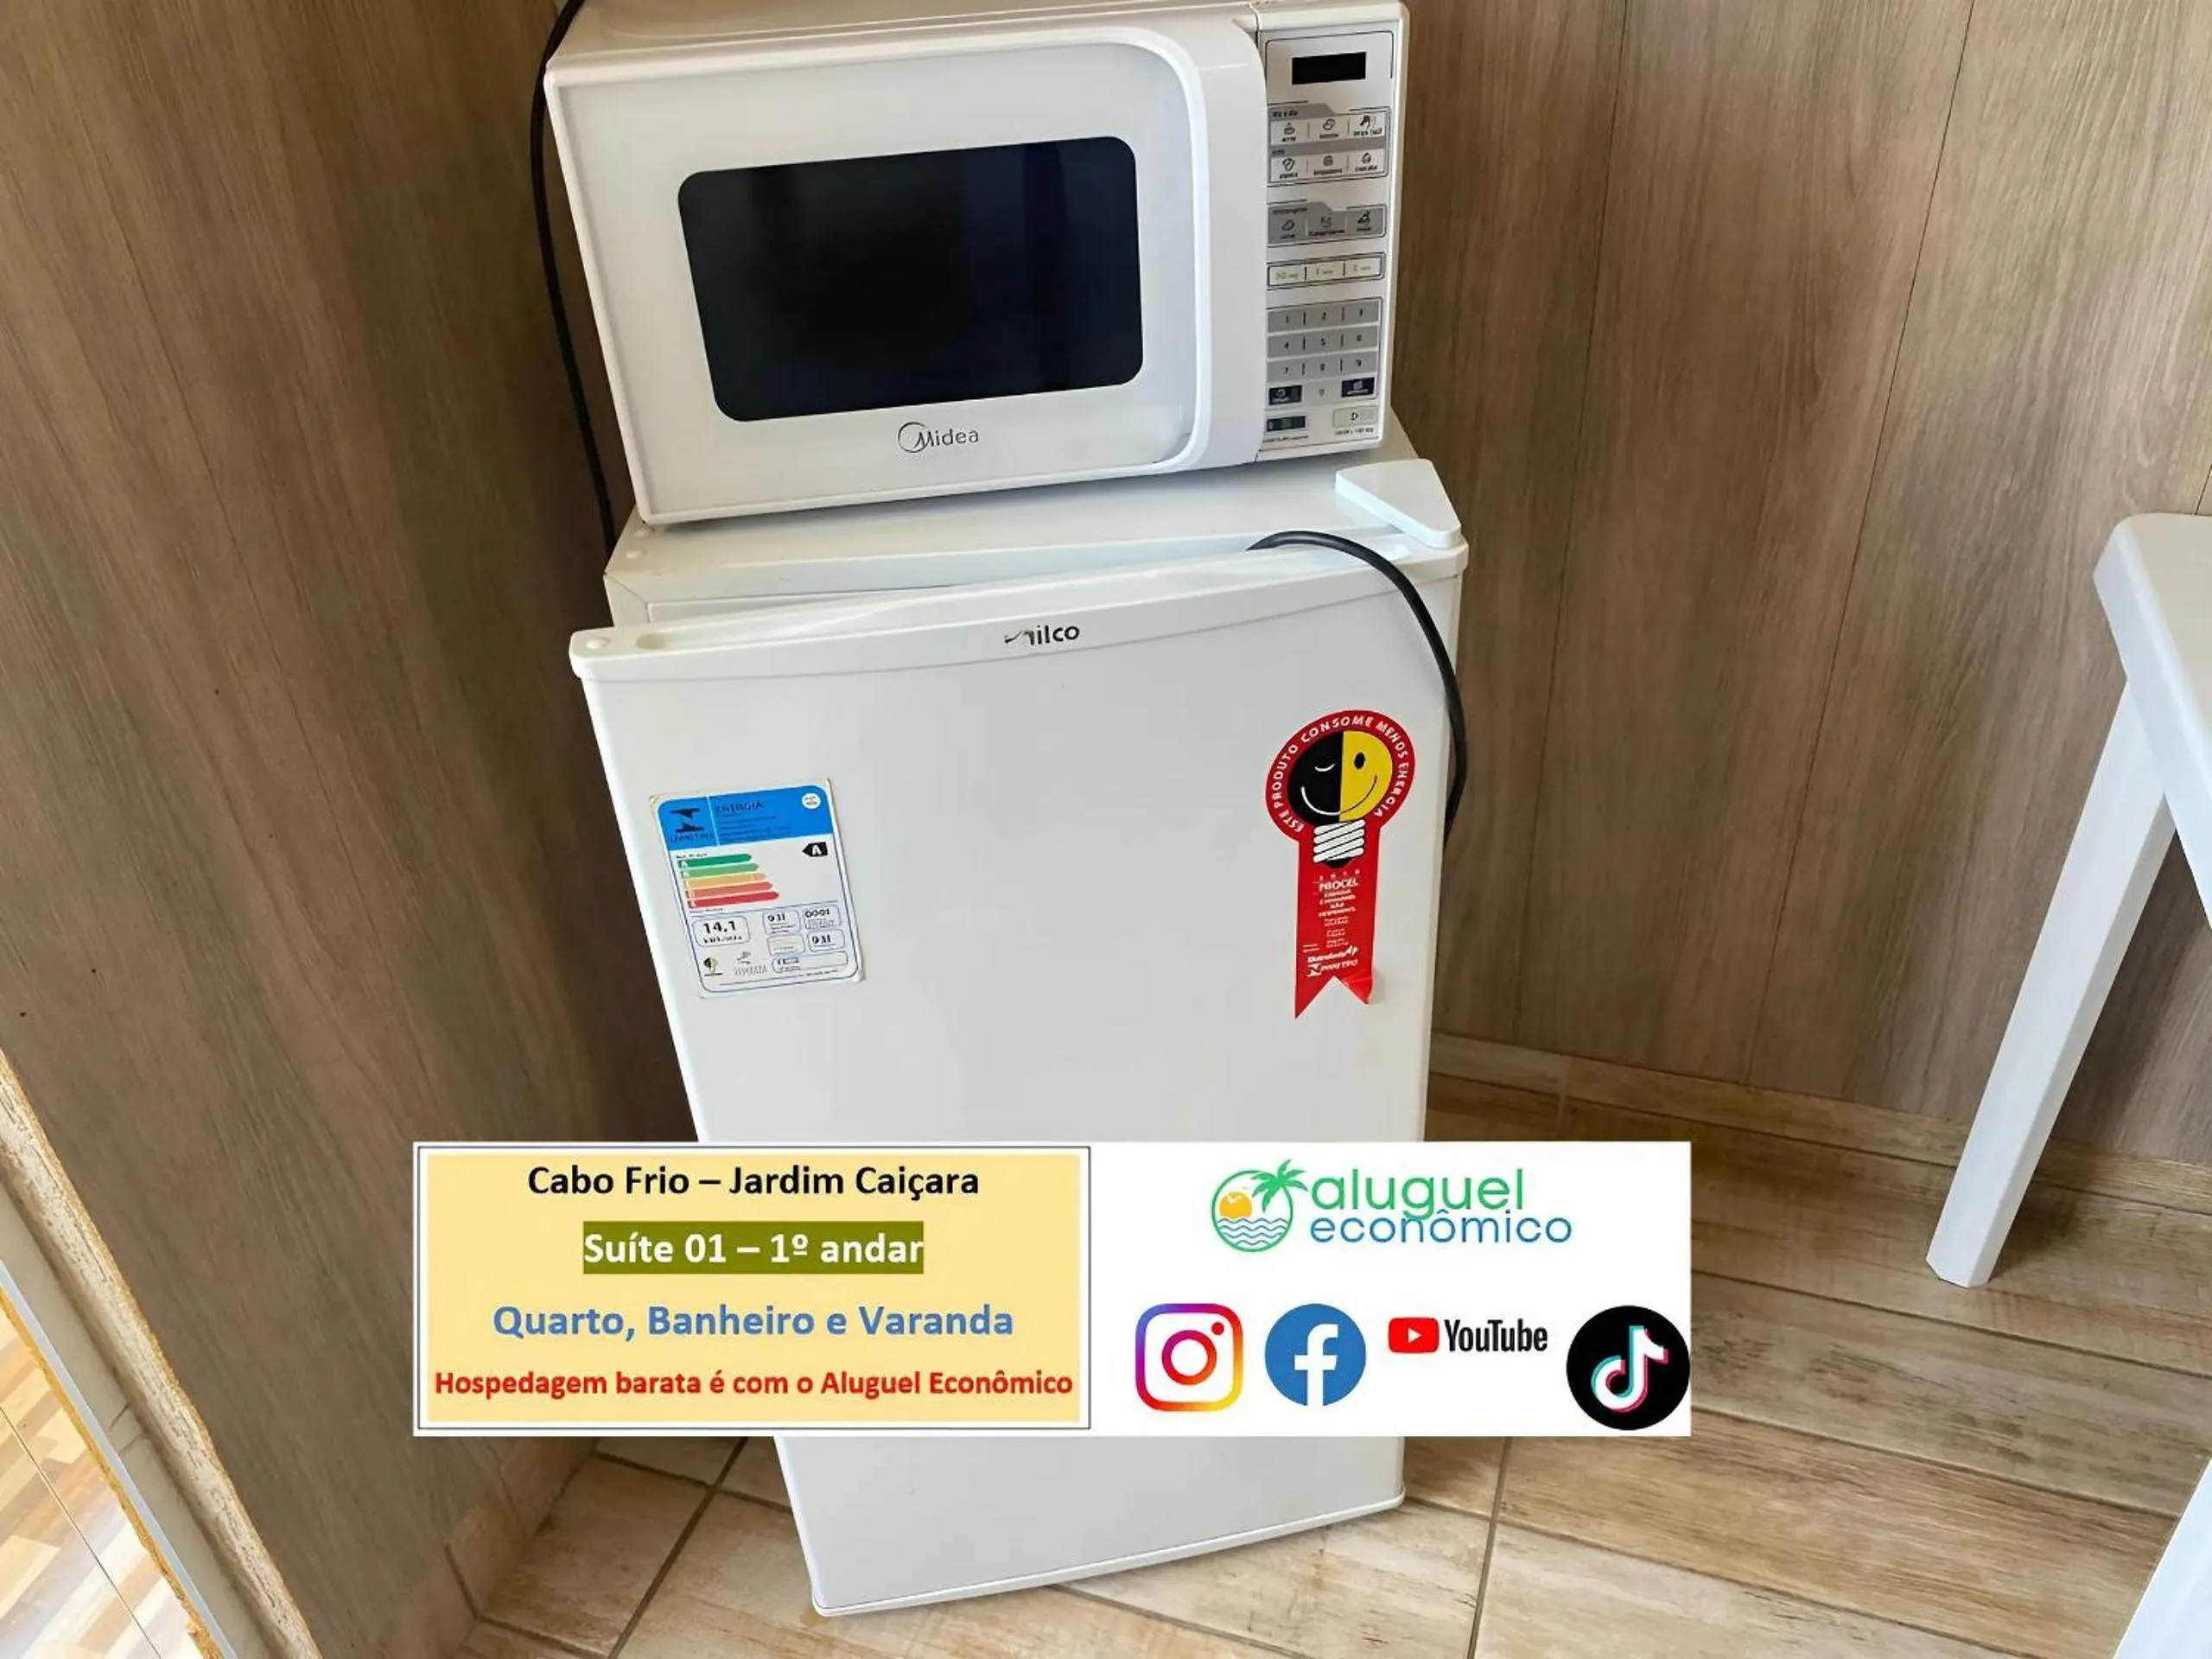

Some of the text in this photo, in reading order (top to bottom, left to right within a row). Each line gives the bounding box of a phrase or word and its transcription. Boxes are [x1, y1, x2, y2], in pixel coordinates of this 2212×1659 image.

[906, 424, 979, 451] Midea
[1004, 624, 1080, 646] ilco
[1278, 809, 1305, 833] ESTE
[1300, 715, 1375, 744] CONSOME
